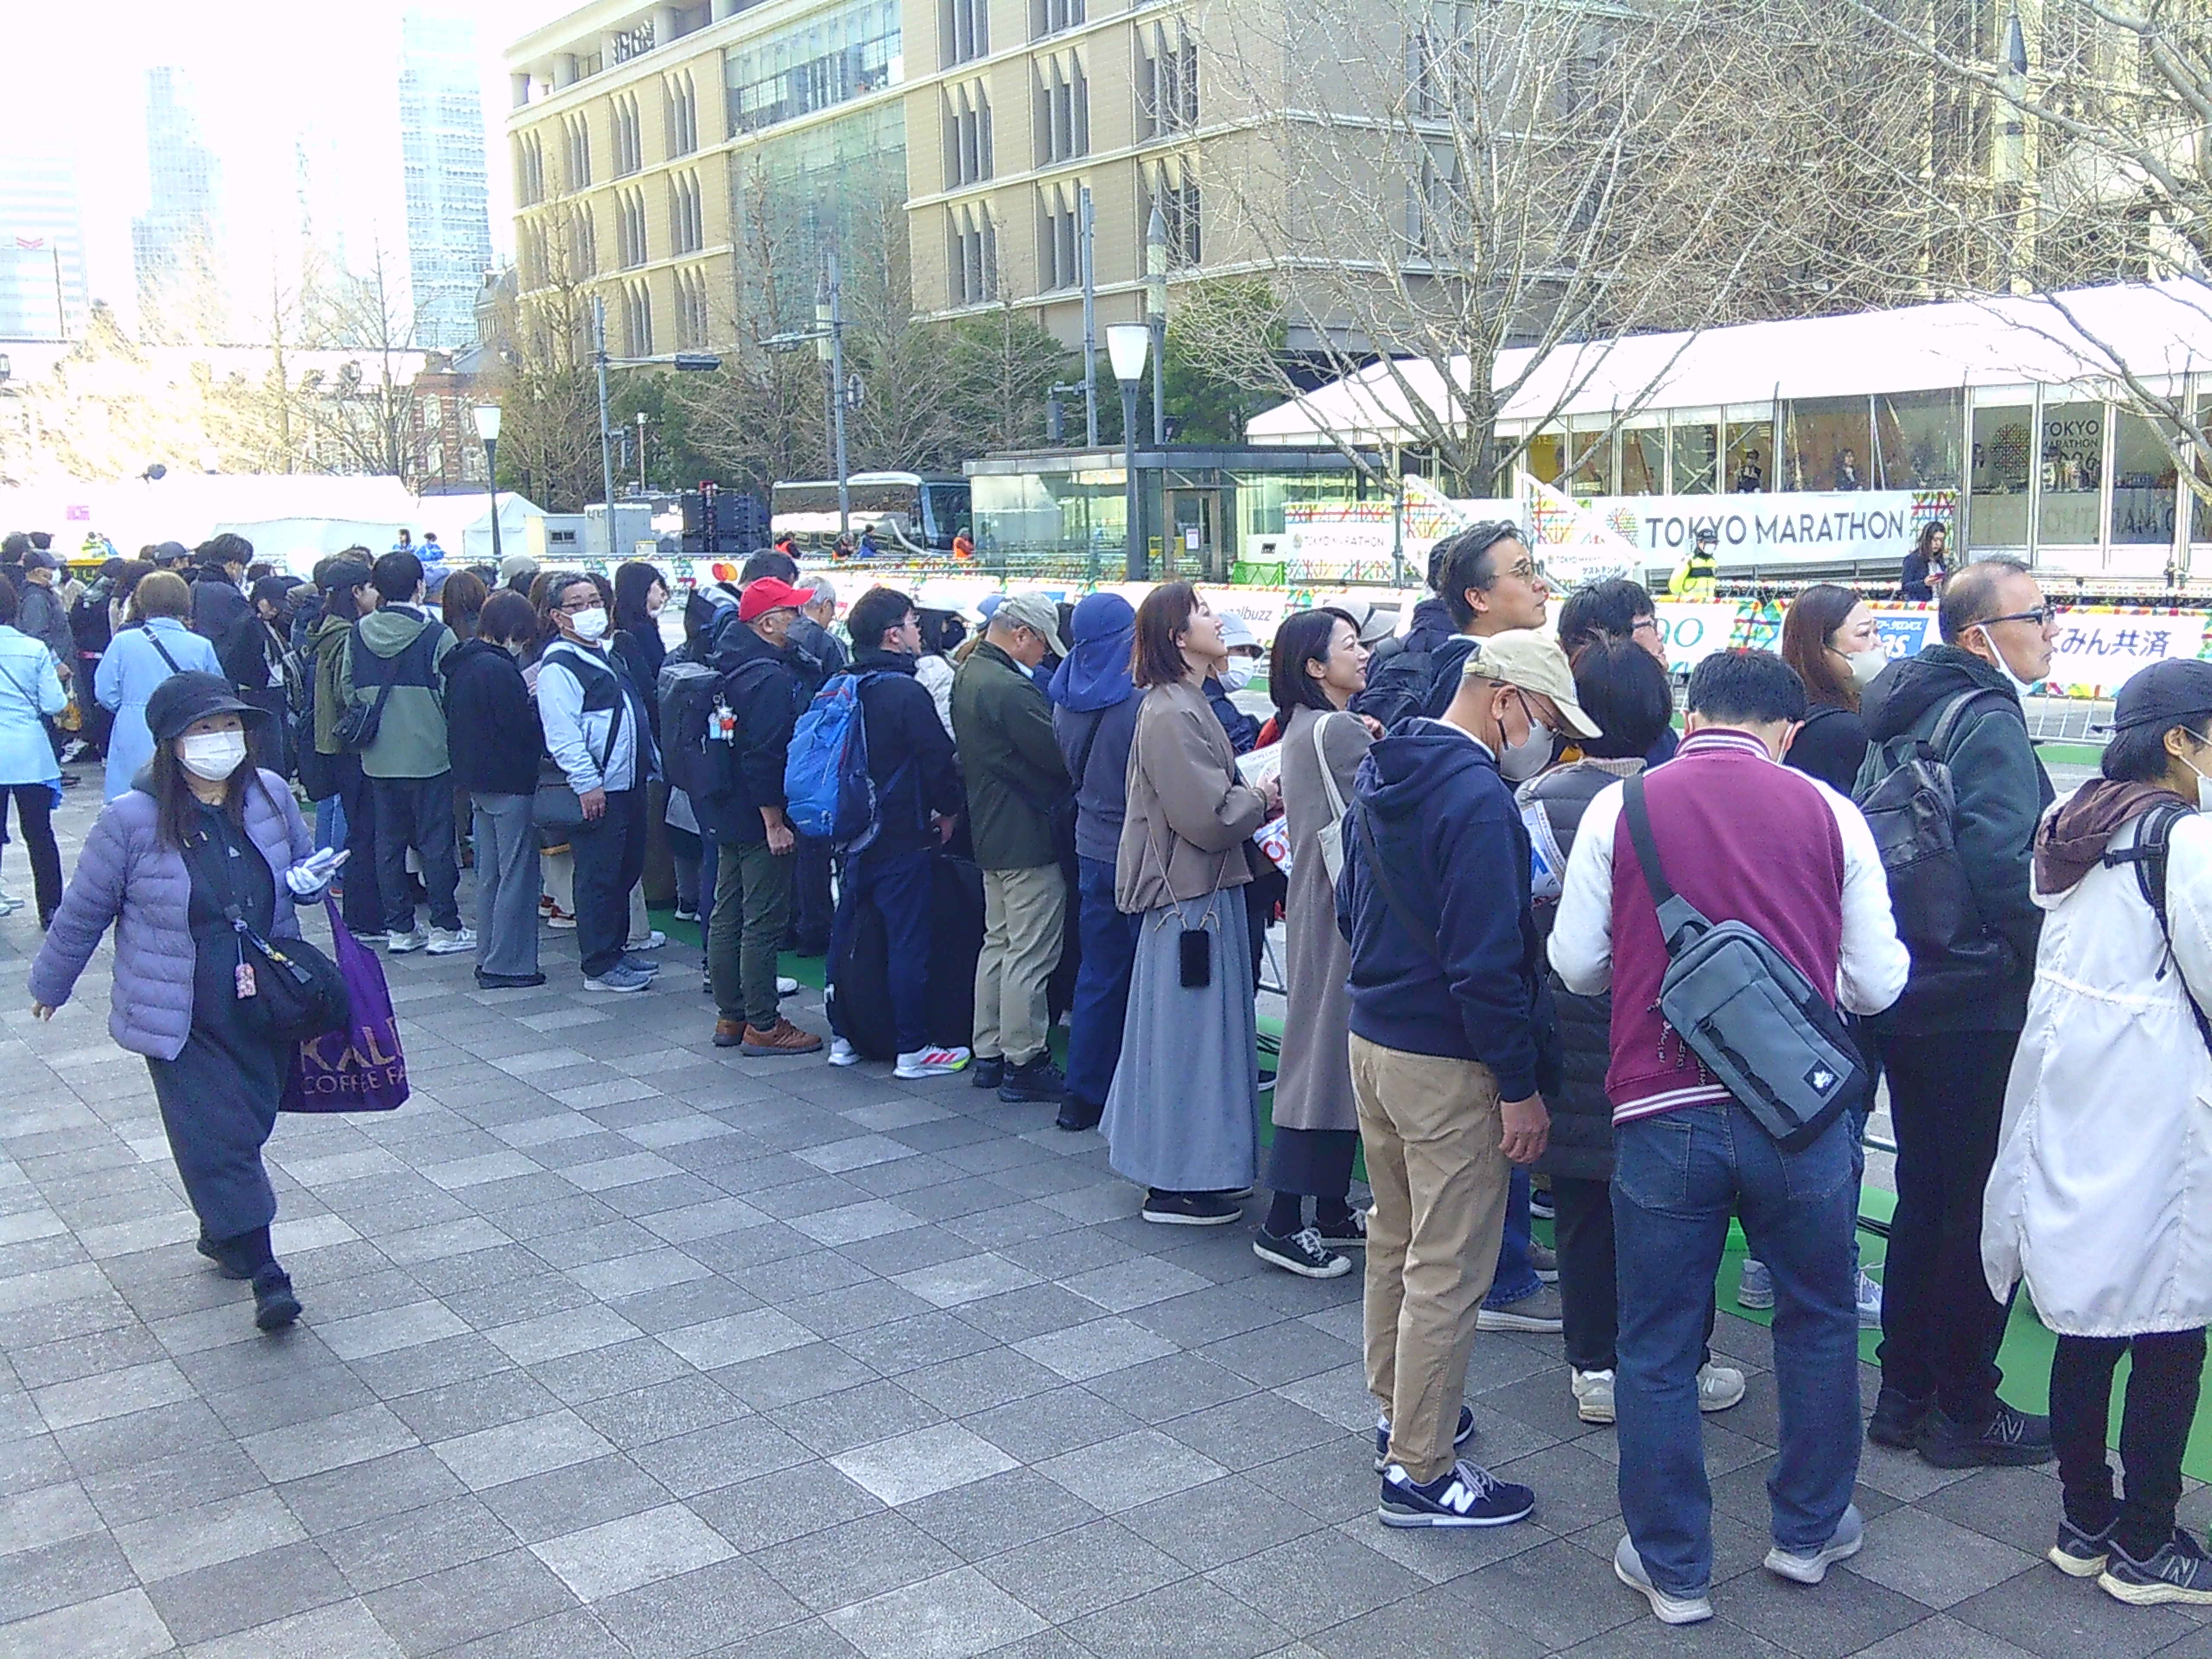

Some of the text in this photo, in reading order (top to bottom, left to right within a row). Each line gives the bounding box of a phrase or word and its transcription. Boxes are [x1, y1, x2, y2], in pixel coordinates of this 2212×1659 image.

[2043, 420, 2099, 437] TOKYO
[1645, 510, 1904, 548] TOKYO MARATHON
[1224, 606, 1273, 621] albuzz
[2053, 628, 2172, 657] みん共済
